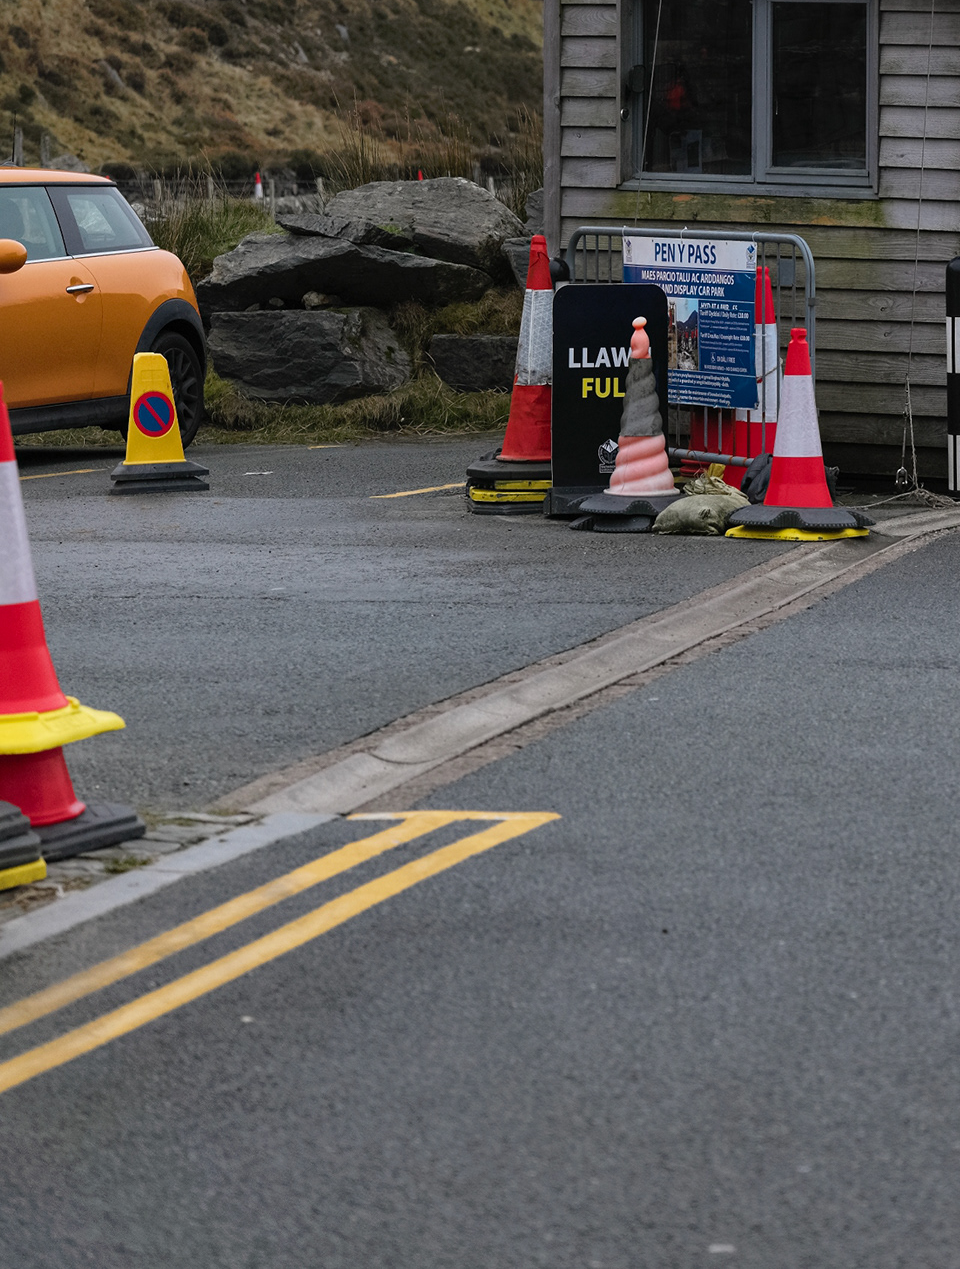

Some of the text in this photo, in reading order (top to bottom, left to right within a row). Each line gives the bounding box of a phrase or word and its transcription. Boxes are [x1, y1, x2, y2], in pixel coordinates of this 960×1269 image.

[654, 242, 717, 264] PEN Y PASS
[641, 270, 735, 285] MAES PARCIO TALU AC ARDDANGOS
[673, 284, 698, 296] DISPLAY
[698, 285, 710, 296] CAR
[710, 286, 725, 297] PARK
[568, 346, 651, 368] LLAW
